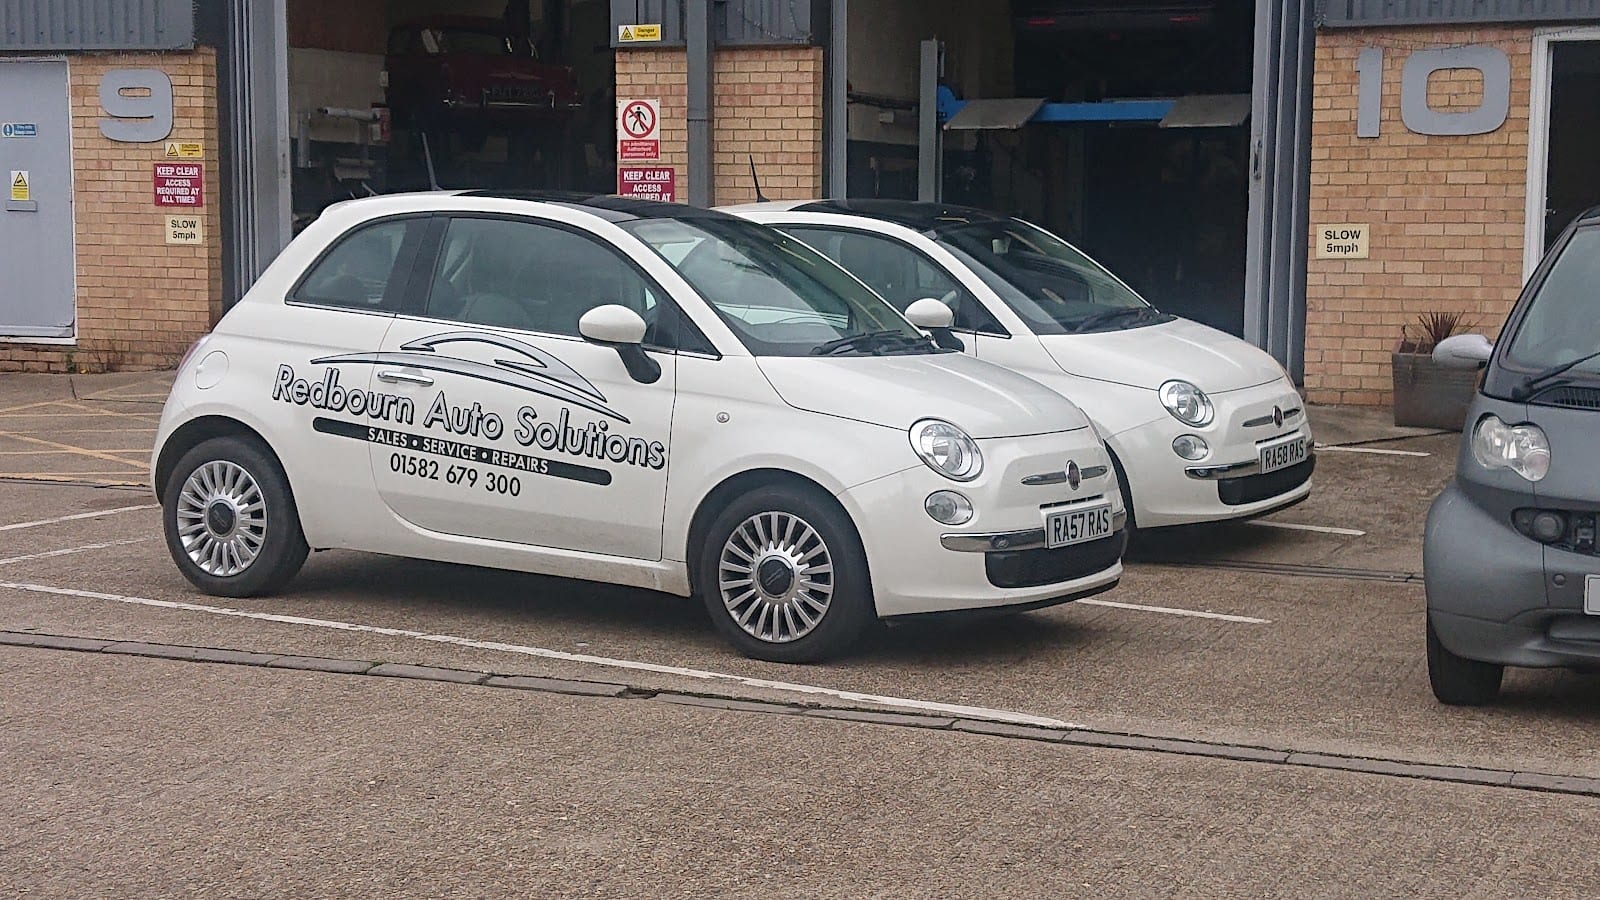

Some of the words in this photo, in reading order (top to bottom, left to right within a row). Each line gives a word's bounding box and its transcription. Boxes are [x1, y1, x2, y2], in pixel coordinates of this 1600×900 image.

[1355, 44, 1511, 138] 10
[99, 68, 174, 143] 9
[157, 167, 174, 176] KEEP
[176, 167, 199, 176] CLEAR
[623, 171, 643, 181] KEEP
[645, 171, 670, 181] CLEAR
[165, 179, 191, 187] ACCESS
[632, 184, 662, 193] ACCESS
[156, 186, 190, 196] REQUIRED
[191, 187, 200, 196] AT
[162, 195, 174, 204] ALL
[175, 195, 196, 204] TIMES
[661, 192, 671, 202] AT
[171, 219, 197, 229] SLOW
[172, 230, 196, 241] 5mph
[1324, 229, 1361, 240] SLOW
[1326, 242, 1359, 255] 5mph
[271, 363, 415, 426] Redbourn
[422, 389, 504, 441] Auto
[513, 405, 666, 470] Solutions
[367, 427, 409, 448] SALES
[422, 438, 477, 460] SERVICE
[491, 450, 549, 474] REPAIRS
[1265, 444, 1288, 470] RA58
[1289, 439, 1305, 462] RAS
[390, 452, 439, 481] 01582
[446, 464, 478, 488] 679
[485, 472, 521, 497] 300
[1053, 513, 1085, 543] RA57
[1088, 508, 1109, 537] RAS
